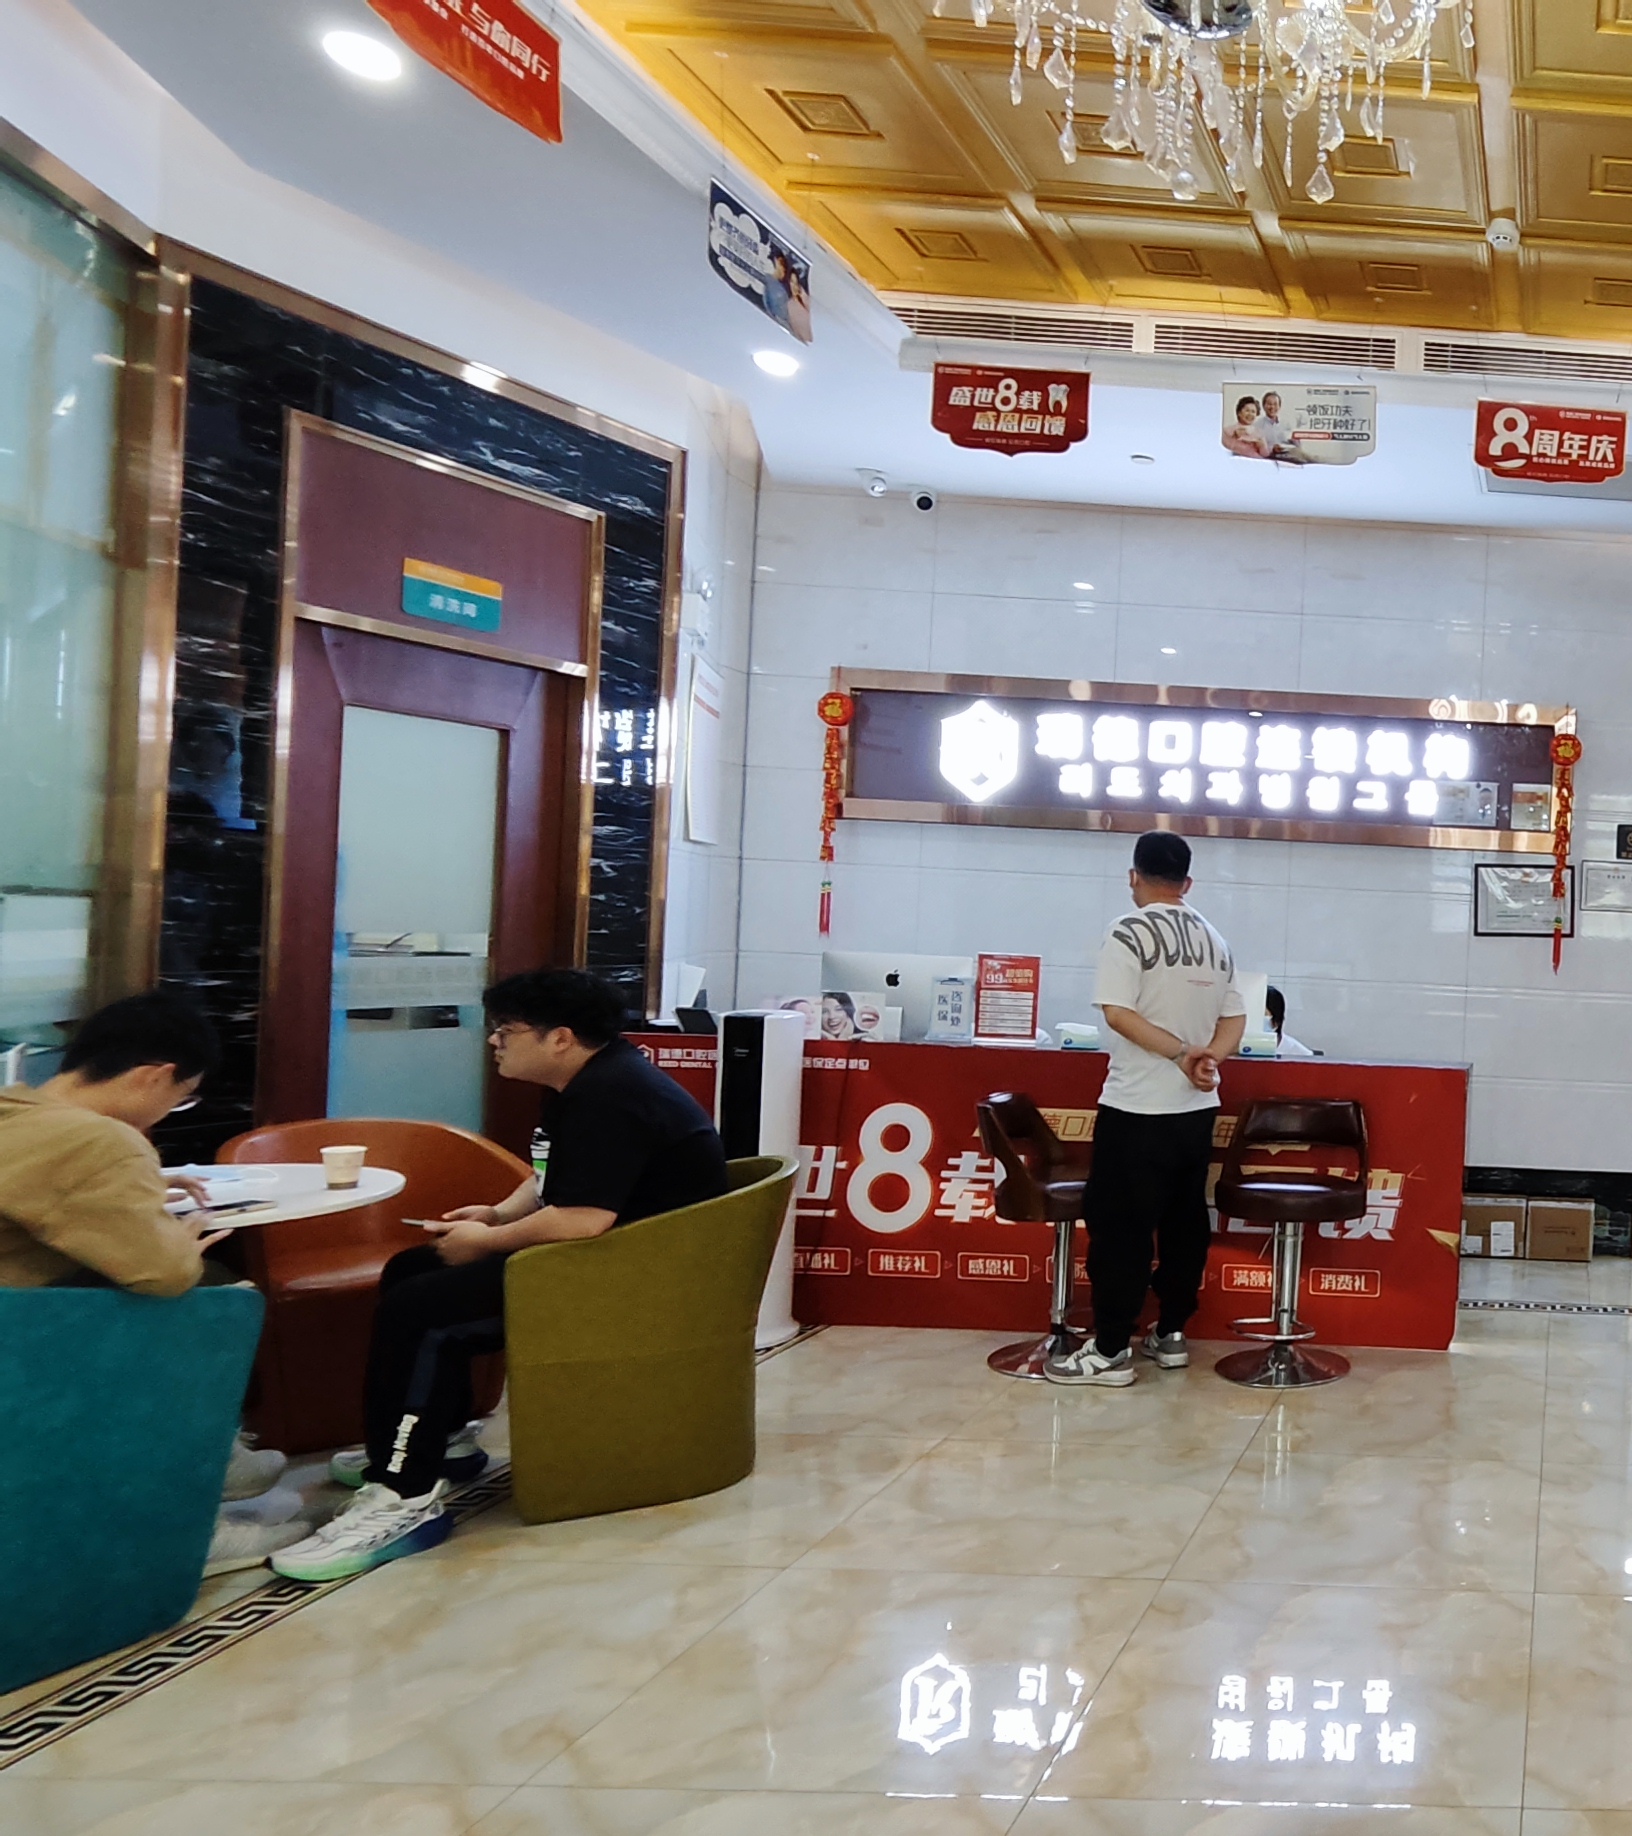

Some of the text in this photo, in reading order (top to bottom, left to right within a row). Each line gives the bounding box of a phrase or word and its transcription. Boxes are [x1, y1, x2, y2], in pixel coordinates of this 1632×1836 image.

[948, 377, 1043, 412] 盛世8载
[972, 410, 1067, 436] 感恩回馈
[878, 1254, 930, 1274] 推荐礼
[967, 1259, 1018, 1277] 感恩礼
[1319, 1272, 1371, 1293] 消费礼
